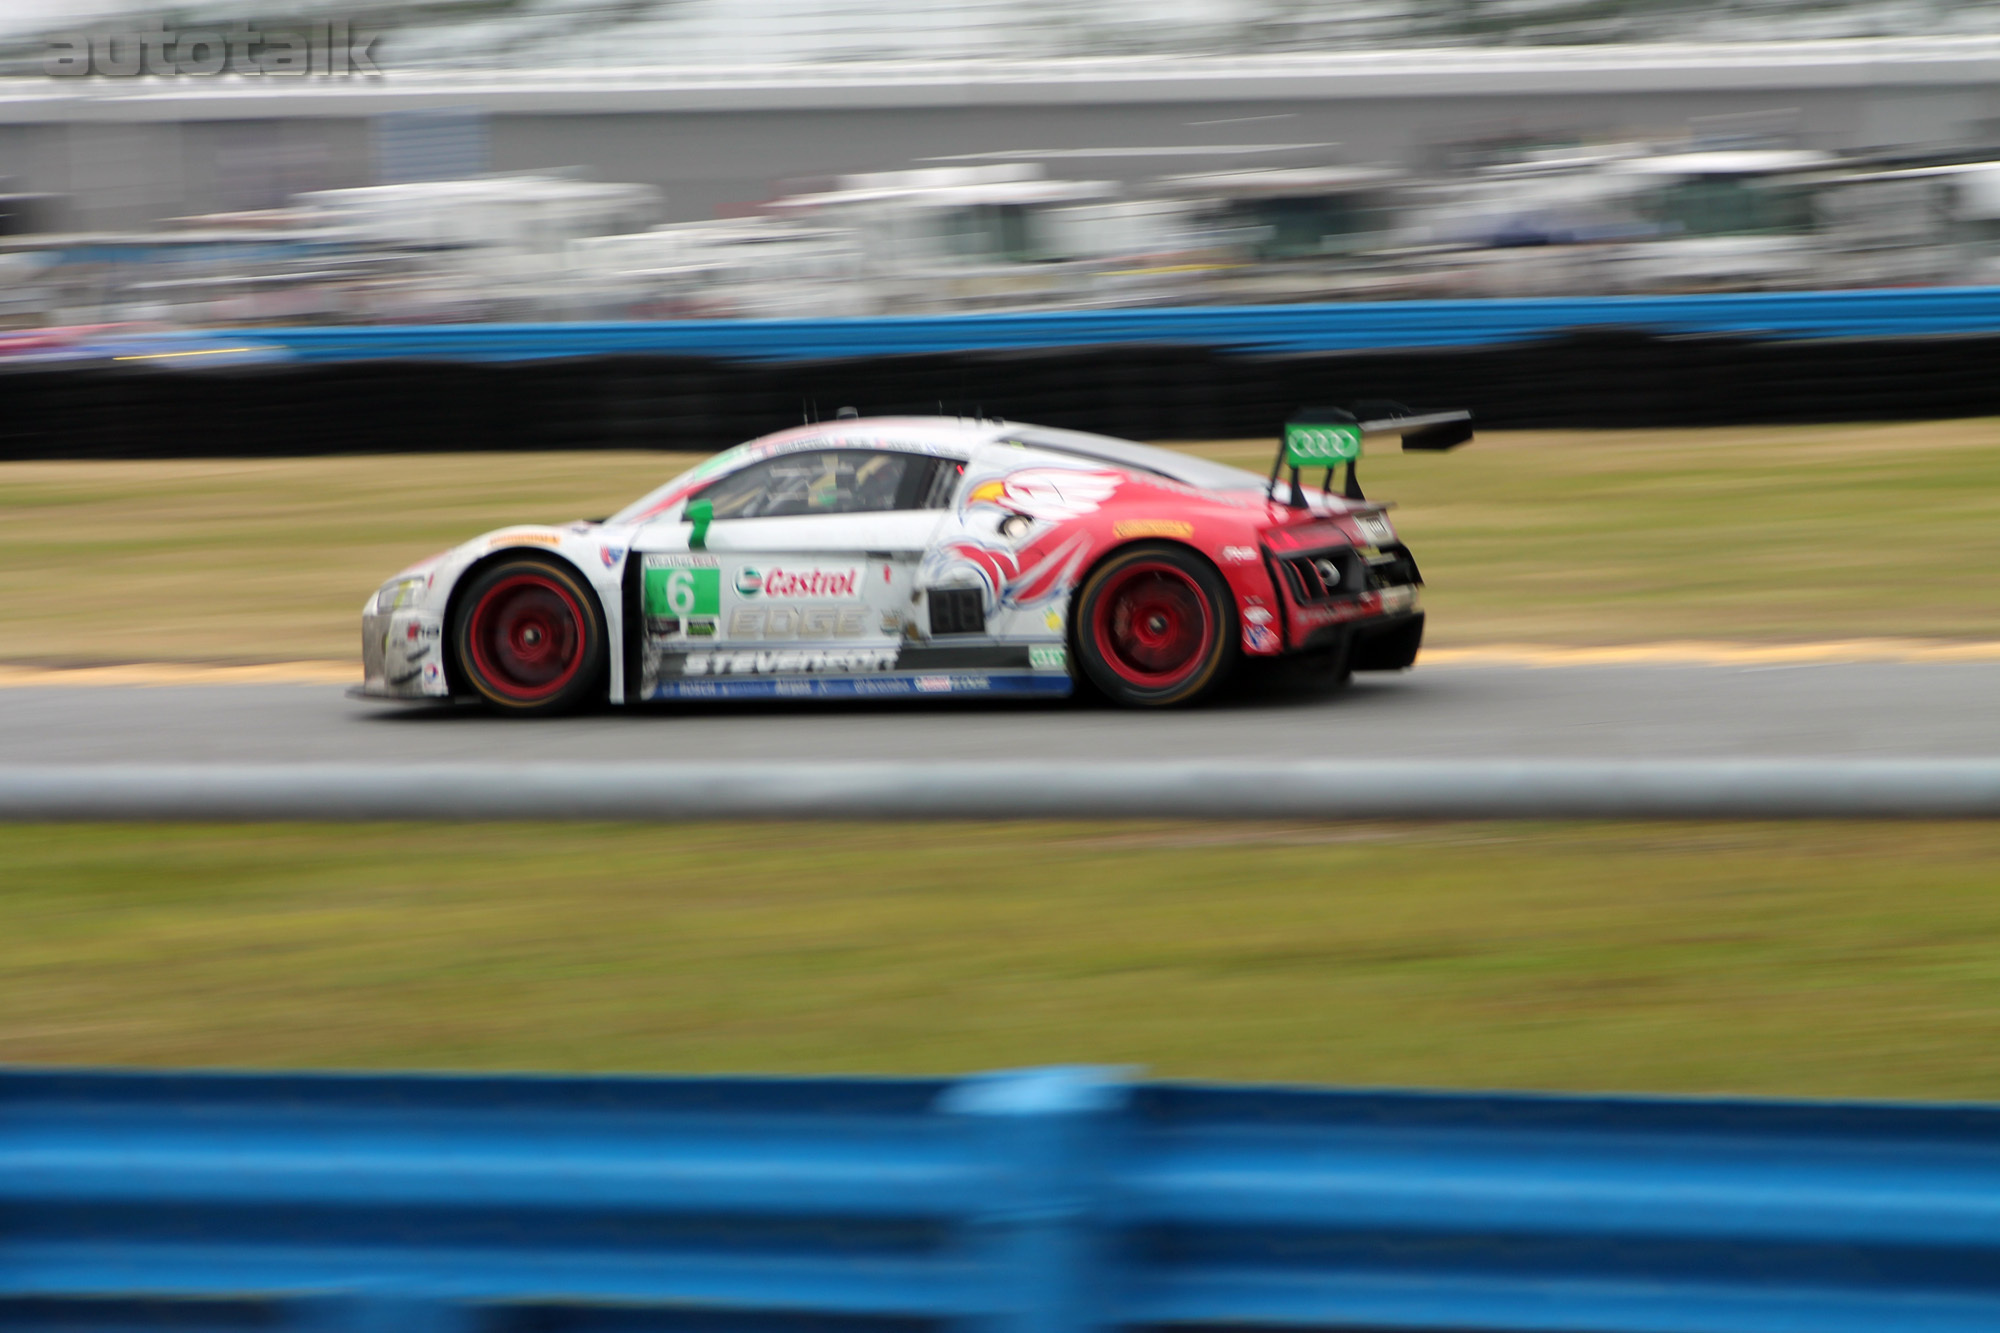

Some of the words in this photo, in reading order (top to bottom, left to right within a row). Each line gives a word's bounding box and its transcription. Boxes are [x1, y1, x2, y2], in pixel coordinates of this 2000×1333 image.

[667, 569, 695, 615] 6
[764, 566, 857, 597] Castrol
[729, 606, 867, 636] EDGE
